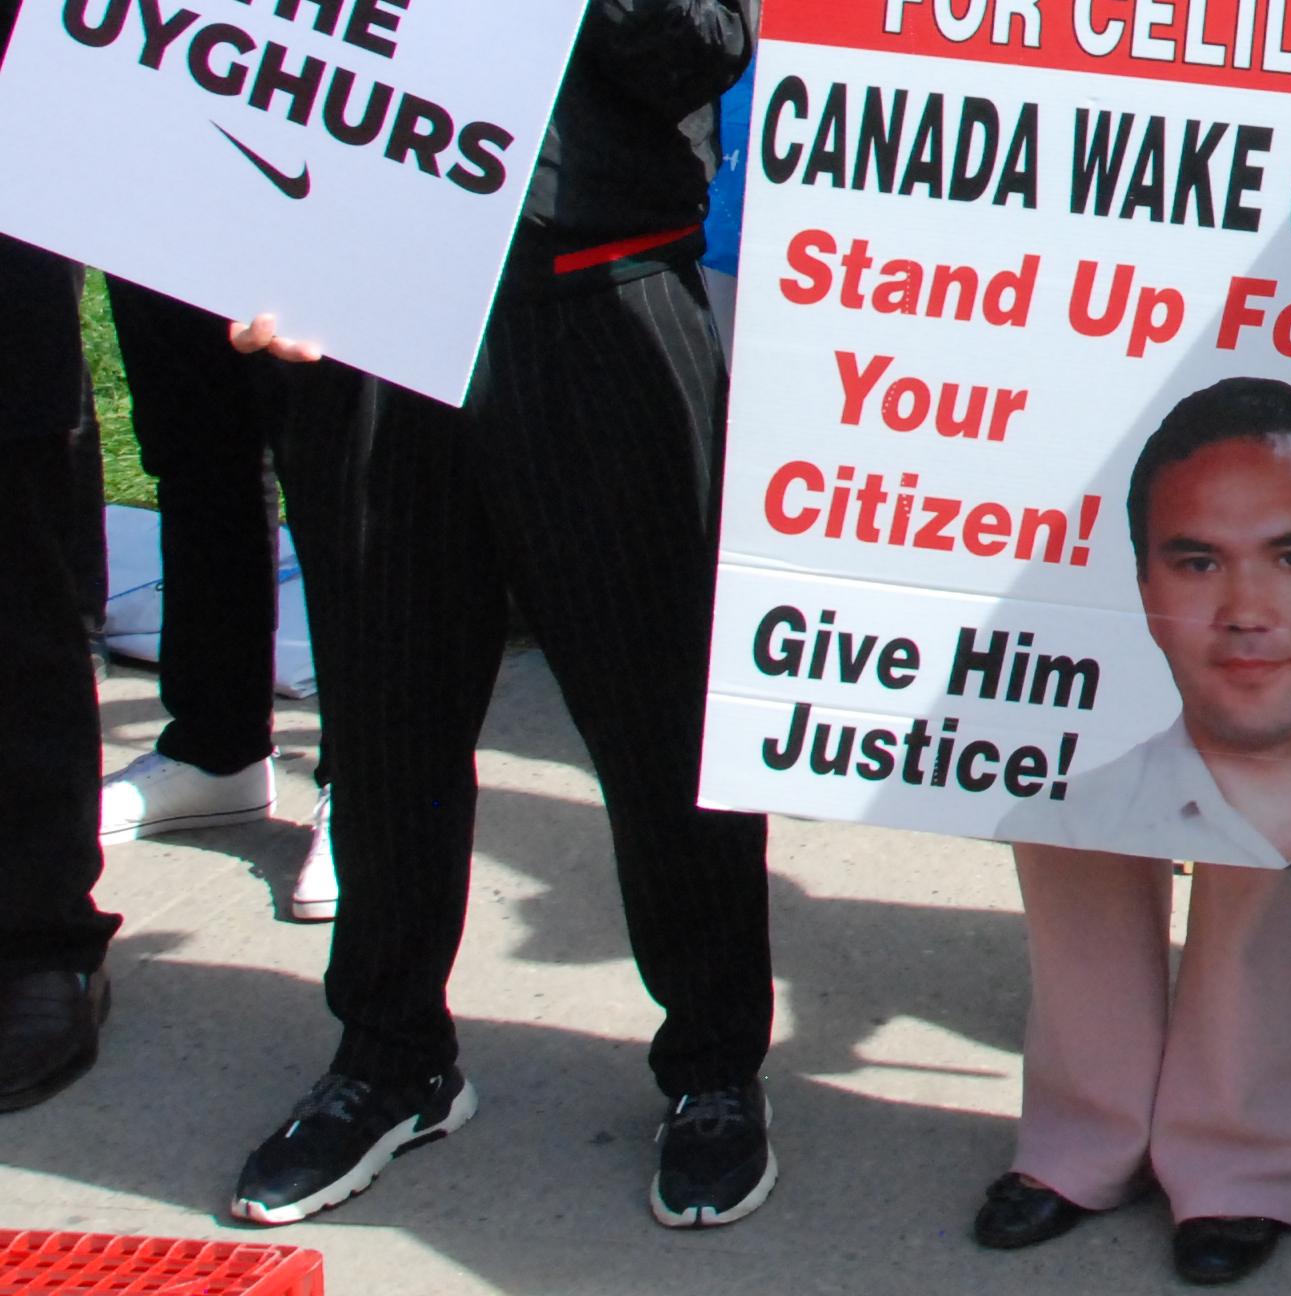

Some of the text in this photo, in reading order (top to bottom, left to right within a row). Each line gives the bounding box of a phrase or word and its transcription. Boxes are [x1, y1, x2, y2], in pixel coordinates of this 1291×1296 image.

[761, 76, 1039, 209] CANADA
[1069, 108, 1273, 233] WAKE
[779, 230, 1039, 328] Stand
[1068, 260, 1184, 358] Up
[834, 351, 1028, 442] Your
[765, 461, 1101, 567] Citizen!
[753, 606, 1101, 710] Give Him
[762, 704, 1078, 800] Justice!
